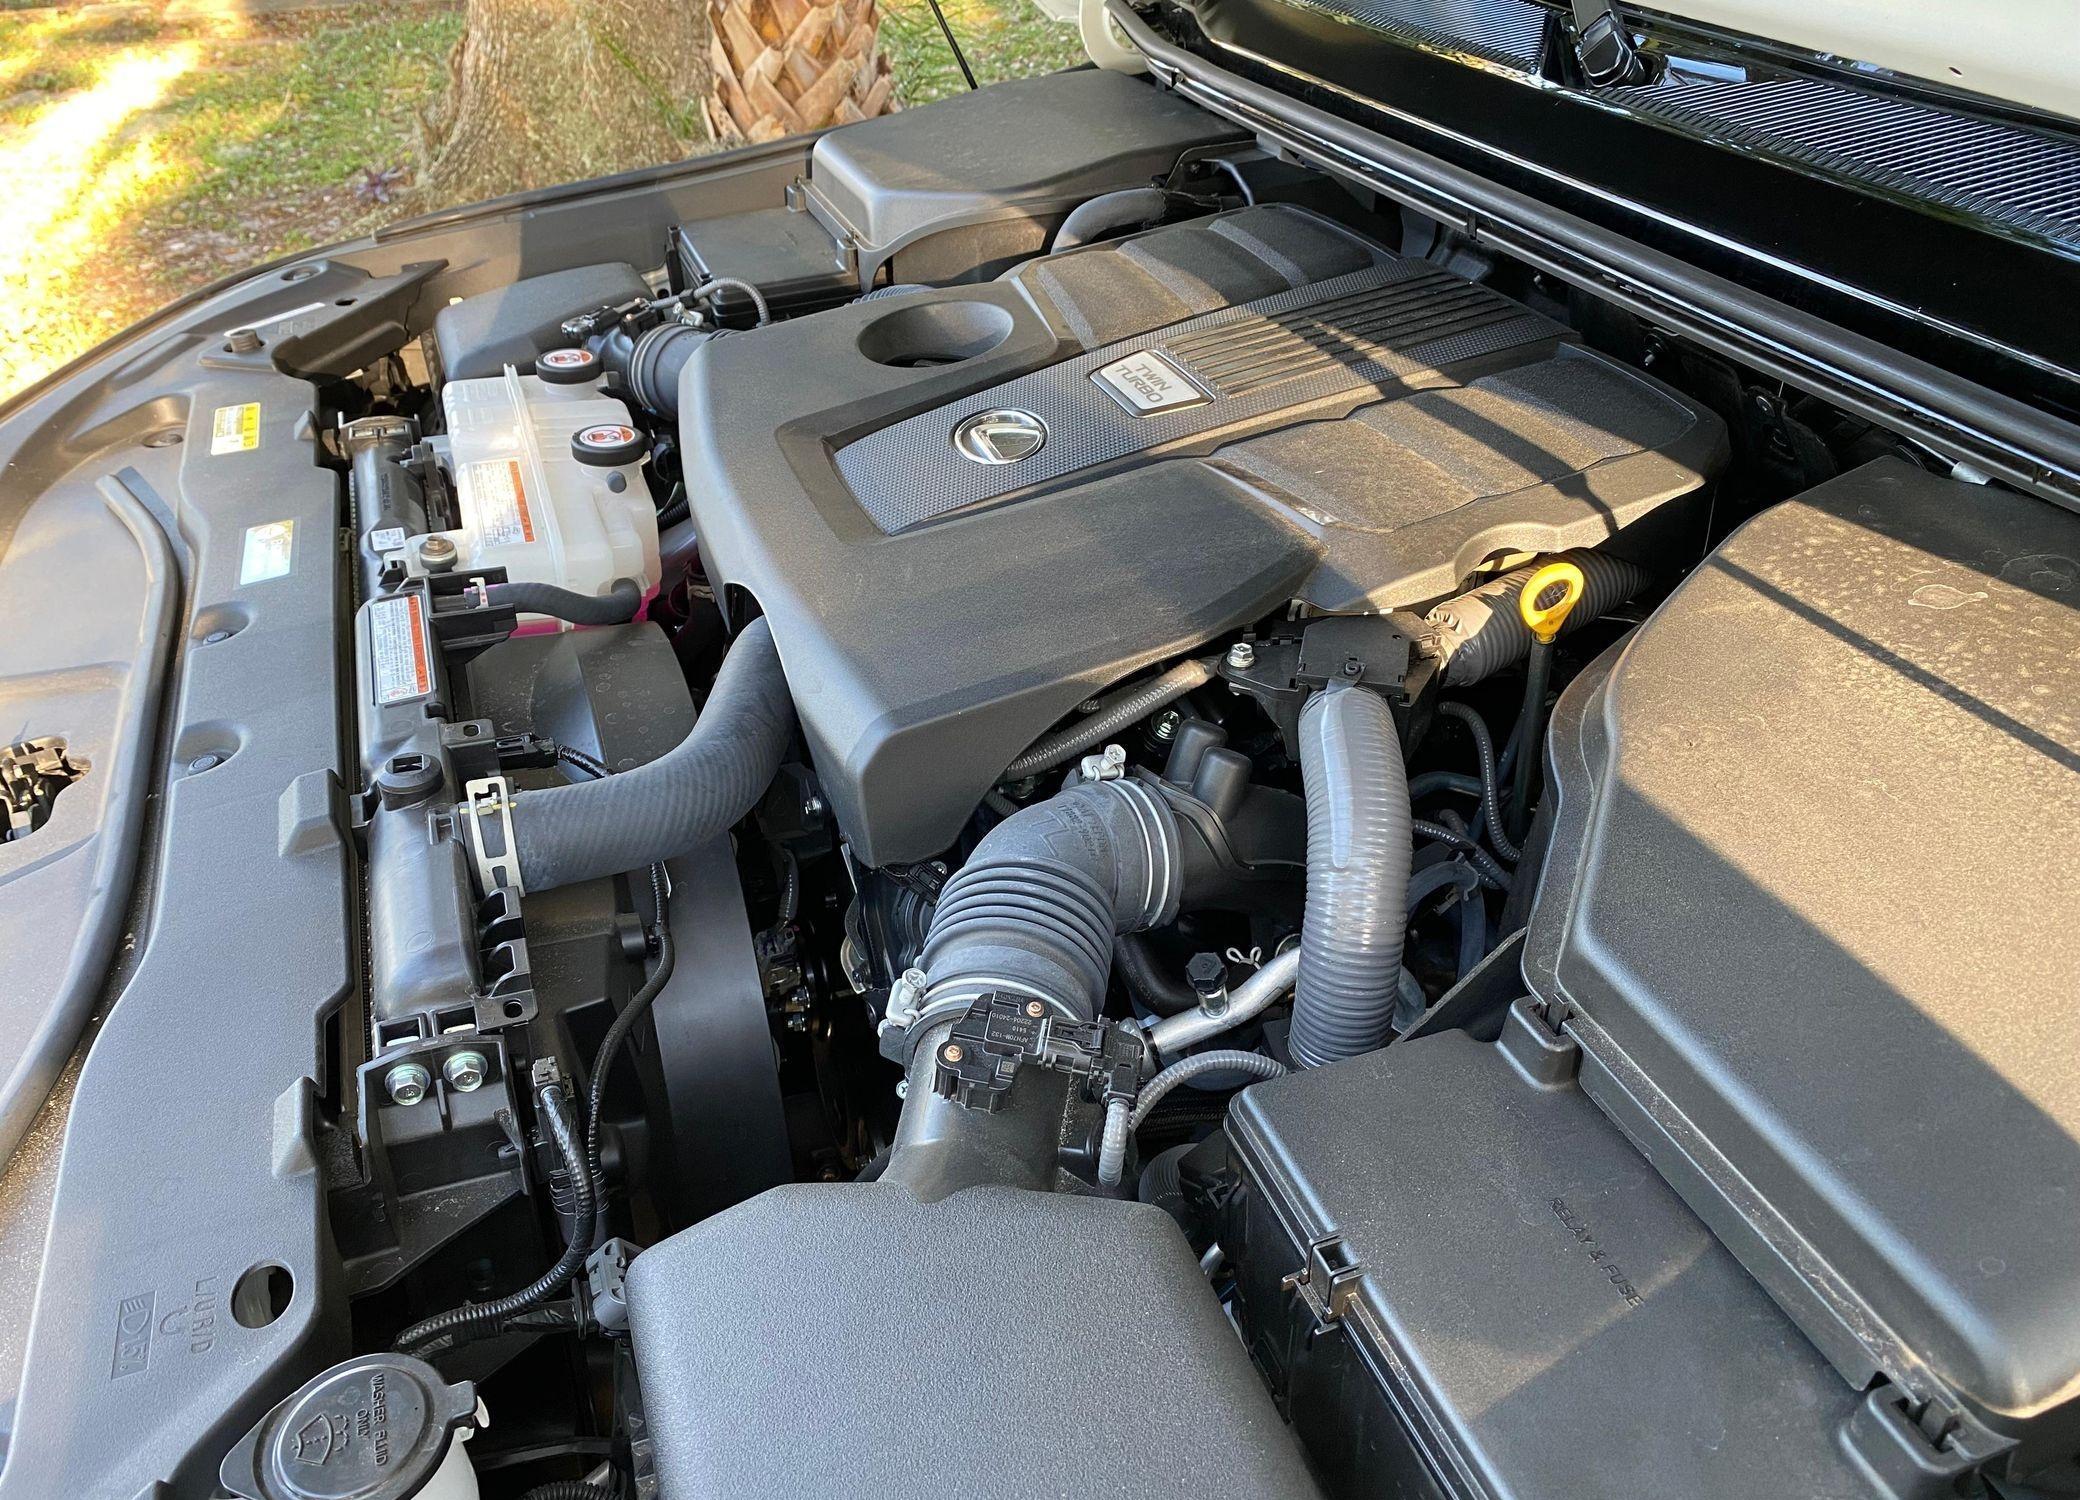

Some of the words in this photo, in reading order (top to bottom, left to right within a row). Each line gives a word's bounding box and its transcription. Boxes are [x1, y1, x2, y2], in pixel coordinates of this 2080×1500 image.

[1115, 364, 1164, 403] TURBO
[1135, 363, 1172, 391] TWIN
[1548, 1198, 1598, 1246] RELAY
[1600, 1264, 1645, 1309] FUSE
[370, 1372, 387, 1426] WASHER
[355, 1408, 371, 1439] ONLY
[373, 1429, 388, 1467] FLUID
